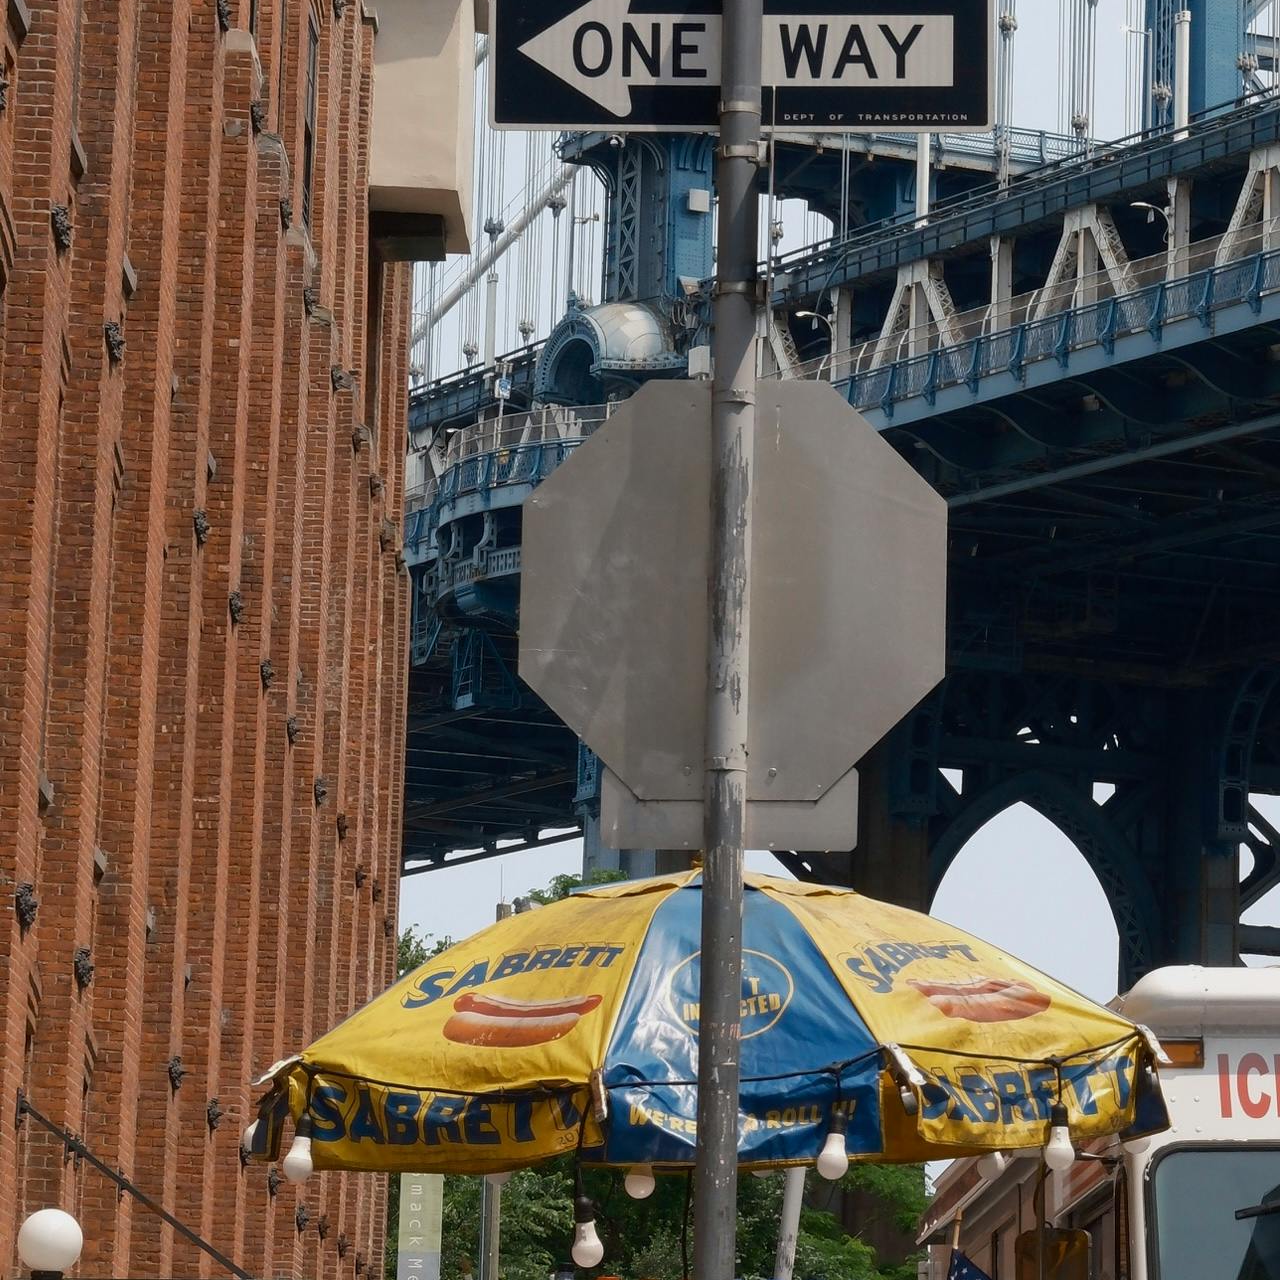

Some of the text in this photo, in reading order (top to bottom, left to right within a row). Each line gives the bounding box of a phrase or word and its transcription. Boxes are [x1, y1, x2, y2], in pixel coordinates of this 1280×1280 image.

[573, 21, 924, 79] ONE WAY
[784, 113, 969, 121] DEPT OF TRANSPORTATION
[402, 943, 625, 1009] SABRETT
[683, 993, 781, 1021] INCTED
[766, 1104, 823, 1129] ROLL
[408, 1173, 425, 1247] mack
